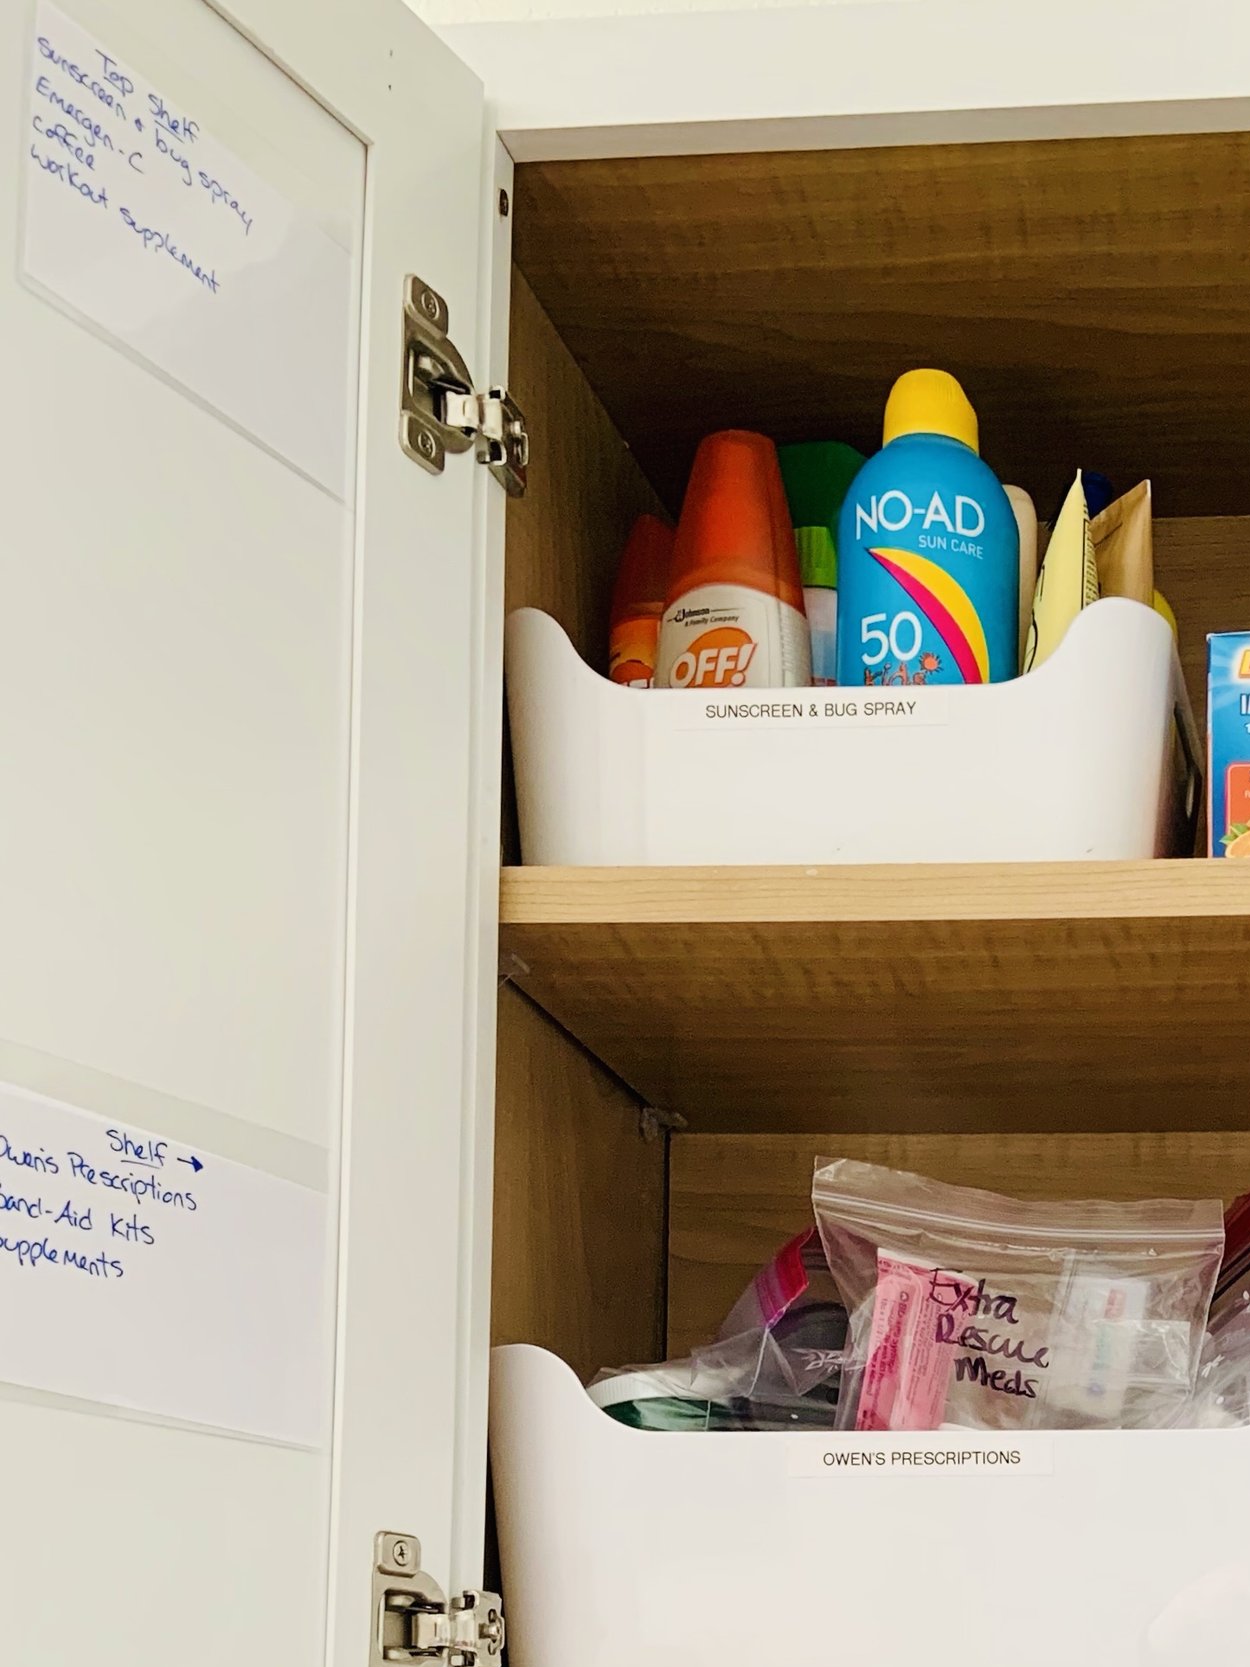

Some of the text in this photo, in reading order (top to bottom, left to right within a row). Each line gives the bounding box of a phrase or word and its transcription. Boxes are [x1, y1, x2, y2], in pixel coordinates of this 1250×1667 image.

[95, 48, 200, 143] Top Shelf
[37, 37, 253, 236] Sunscreen bug spray
[120, 207, 220, 294] supplement
[856, 490, 985, 540] NO-AD
[918, 535, 984, 560] SUN CARE
[861, 611, 922, 665] 50
[669, 643, 757, 688] OFF!
[705, 701, 917, 719] SUNSCREEN & BUG SPRAY
[106, 1129, 168, 1166] Shelf
[67, 1151, 197, 1211] Prescriptions
[112, 1214, 155, 1245] Kits
[929, 1268, 1018, 1324] Extra
[936, 1314, 1049, 1367] Rescue
[955, 1356, 1039, 1399] Meds
[823, 1451, 1021, 1467] OWEN'S PRESCRIPTIONS
